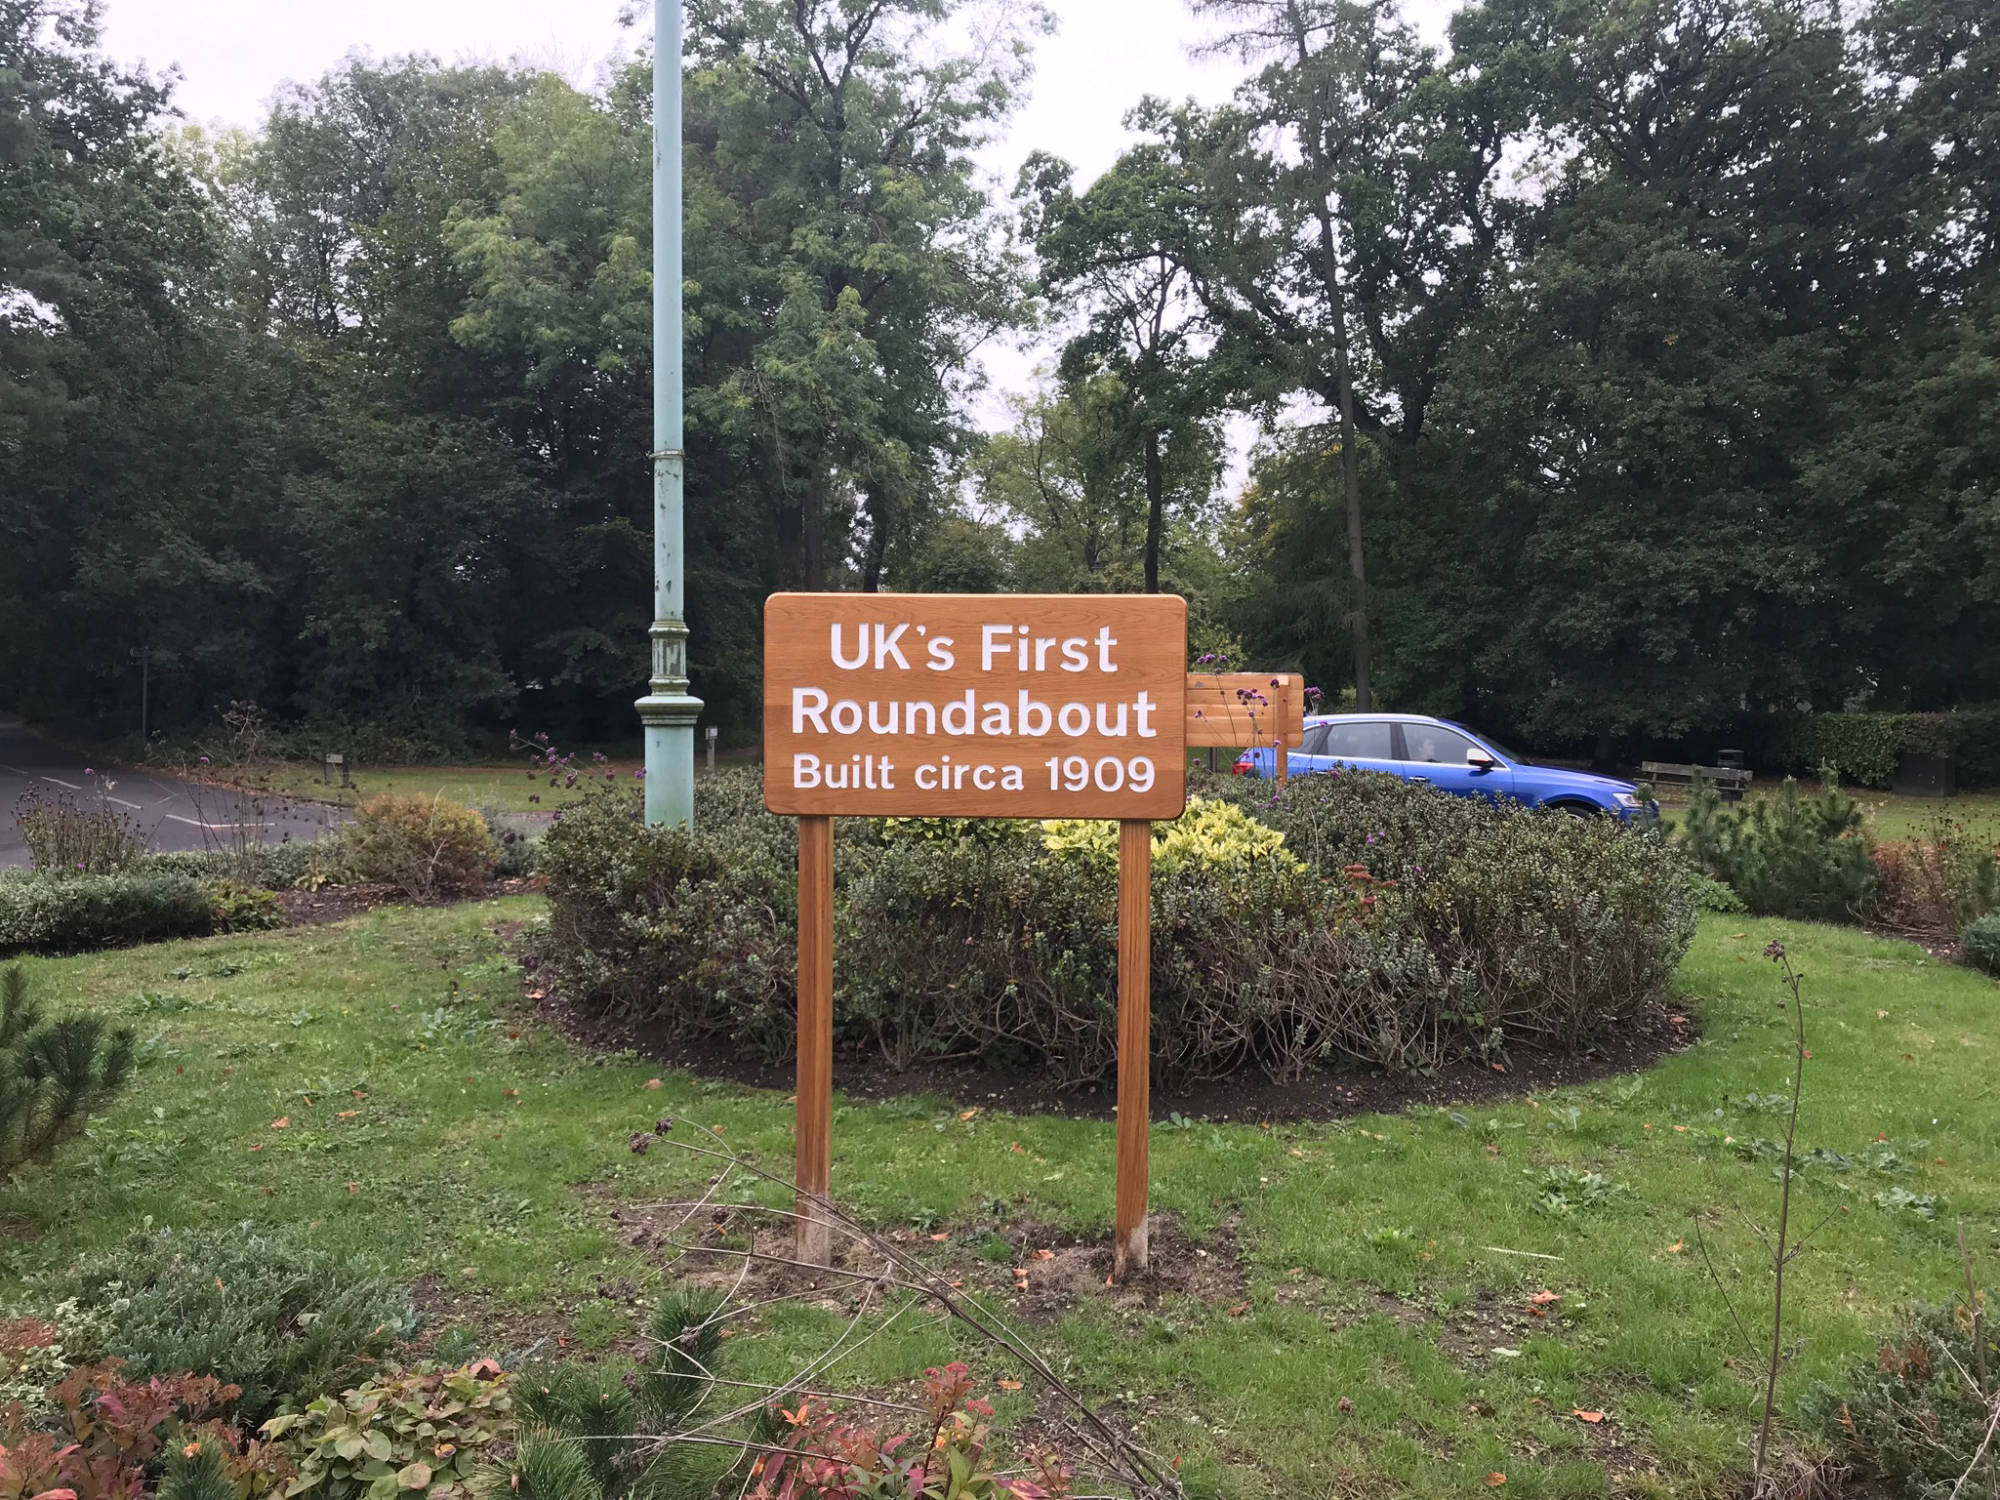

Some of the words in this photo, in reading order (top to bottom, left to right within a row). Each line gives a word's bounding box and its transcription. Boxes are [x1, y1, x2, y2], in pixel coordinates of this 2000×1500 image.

[830, 623, 955, 672] UK's
[981, 624, 1118, 673] First
[792, 686, 1157, 738] Roundabout
[793, 753, 895, 790] Built
[914, 754, 1025, 791] circa
[1044, 755, 1156, 793] 1909
